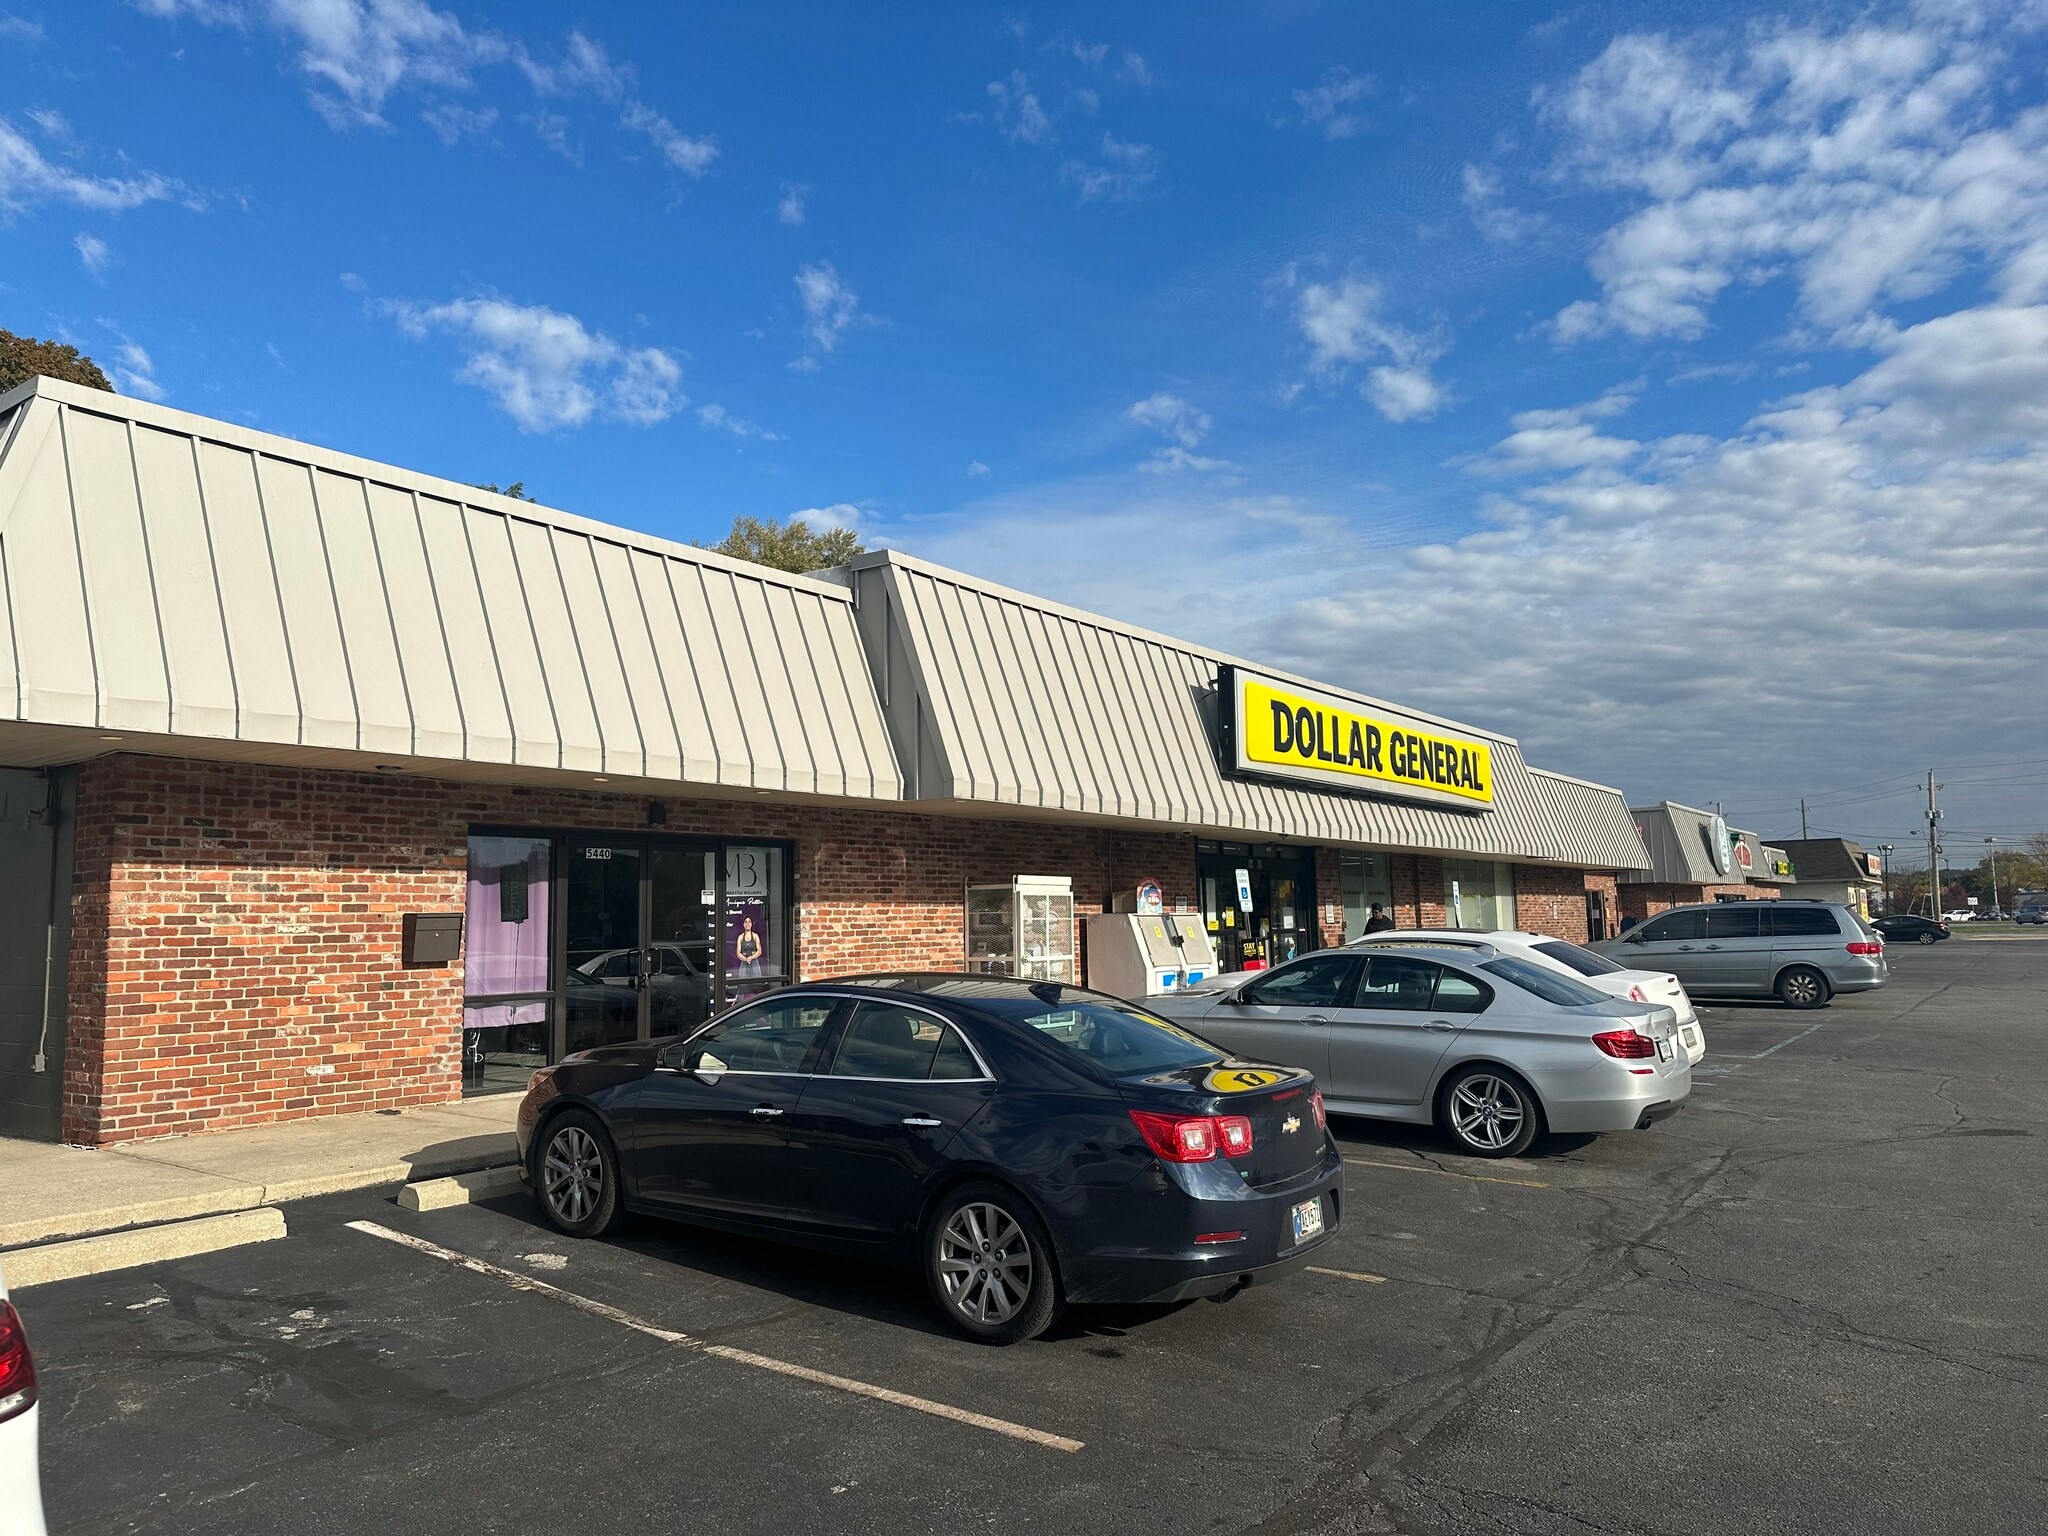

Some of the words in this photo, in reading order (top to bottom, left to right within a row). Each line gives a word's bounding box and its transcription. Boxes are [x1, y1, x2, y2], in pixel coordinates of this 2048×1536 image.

[1270, 699, 1383, 772] DOLLAR
[1389, 731, 1484, 791] GENERAL
[586, 848, 611, 859] 5440
[510, 871, 521, 915] OPEN
